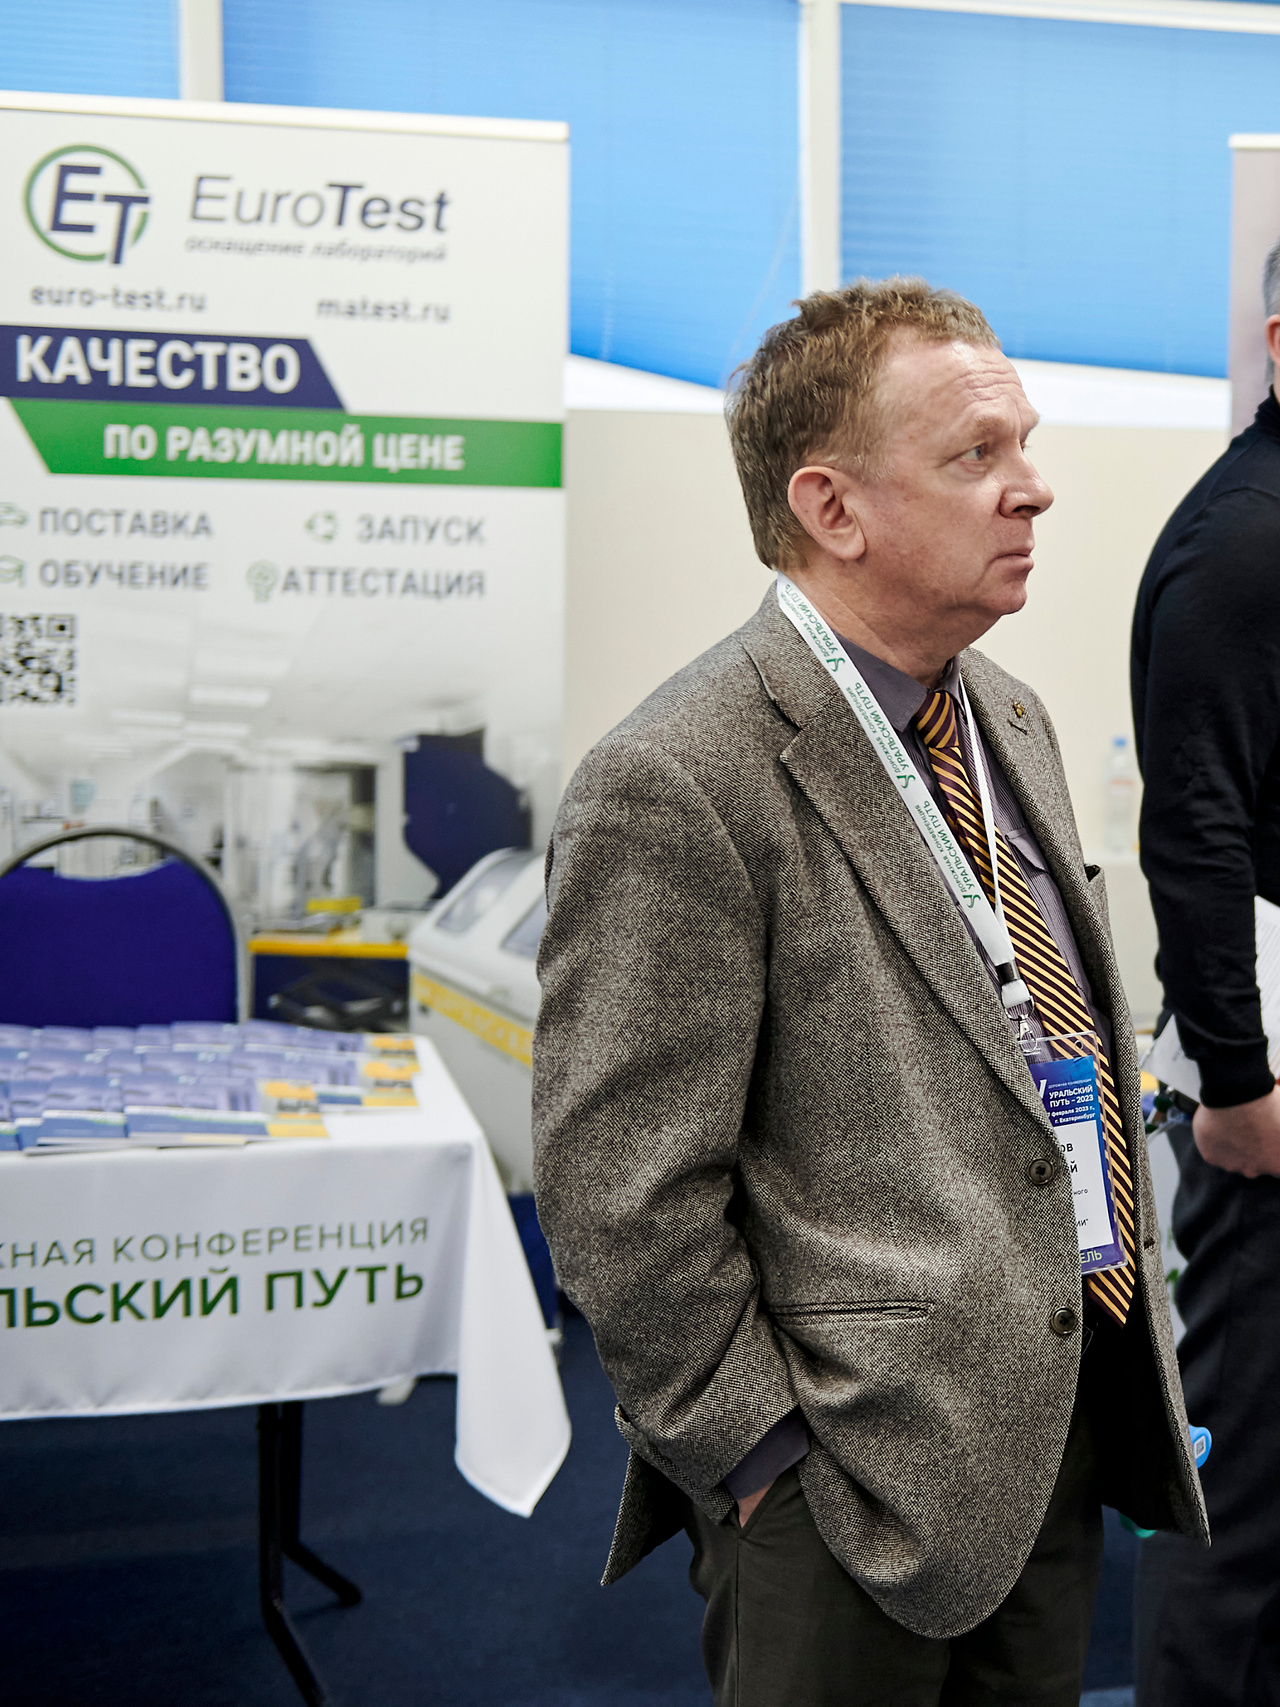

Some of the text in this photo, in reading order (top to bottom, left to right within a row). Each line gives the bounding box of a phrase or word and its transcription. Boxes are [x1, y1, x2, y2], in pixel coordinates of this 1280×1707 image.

[190, 175, 452, 232] EuroTest
[185, 237, 446, 262] оснащение лабораторий
[31, 286, 206, 312] euro-test.ru
[318, 296, 450, 322] matest.ru
[16, 335, 300, 394] КАЧЕСТВО
[103, 424, 465, 472] ПО РАЗУМНОЙ ЦЕНЕ
[39, 508, 213, 538] ПОСТАВКА
[357, 515, 485, 546] ЗАПУСК
[40, 560, 209, 591] ОБУЧЕНИЕ
[281, 567, 485, 599] АТТЕСТАЦИЯ
[784, 583, 838, 654] УРАЛЬСКИЙ ПУТЬ
[845, 686, 901, 773] ДОРОЖНАЯ КОНФЕРЕНЦИЯ
[854, 682, 909, 771] УРАЛЬСКИЙ ПУТЬ
[914, 804, 967, 893] ДОРОЖНАЯ КОНФЕРЕНЦИЯ
[923, 800, 975, 890] УРАЛЬСКИЙ ПУТЬ
[1049, 1085, 1093, 1099] УРАЛЬСКИЙ
[1050, 1099, 1070, 1108] ПУТЬ
[1076, 1094, 1094, 1104] 2023
[1051, 1109, 1075, 1118] февраля
[1060, 1112, 1096, 1124] Екатеринбург
[0, 1217, 429, 1270] НАЯ КОНФЕРЕНЦИЯ
[265, 1263, 425, 1311] ПУТЬ
